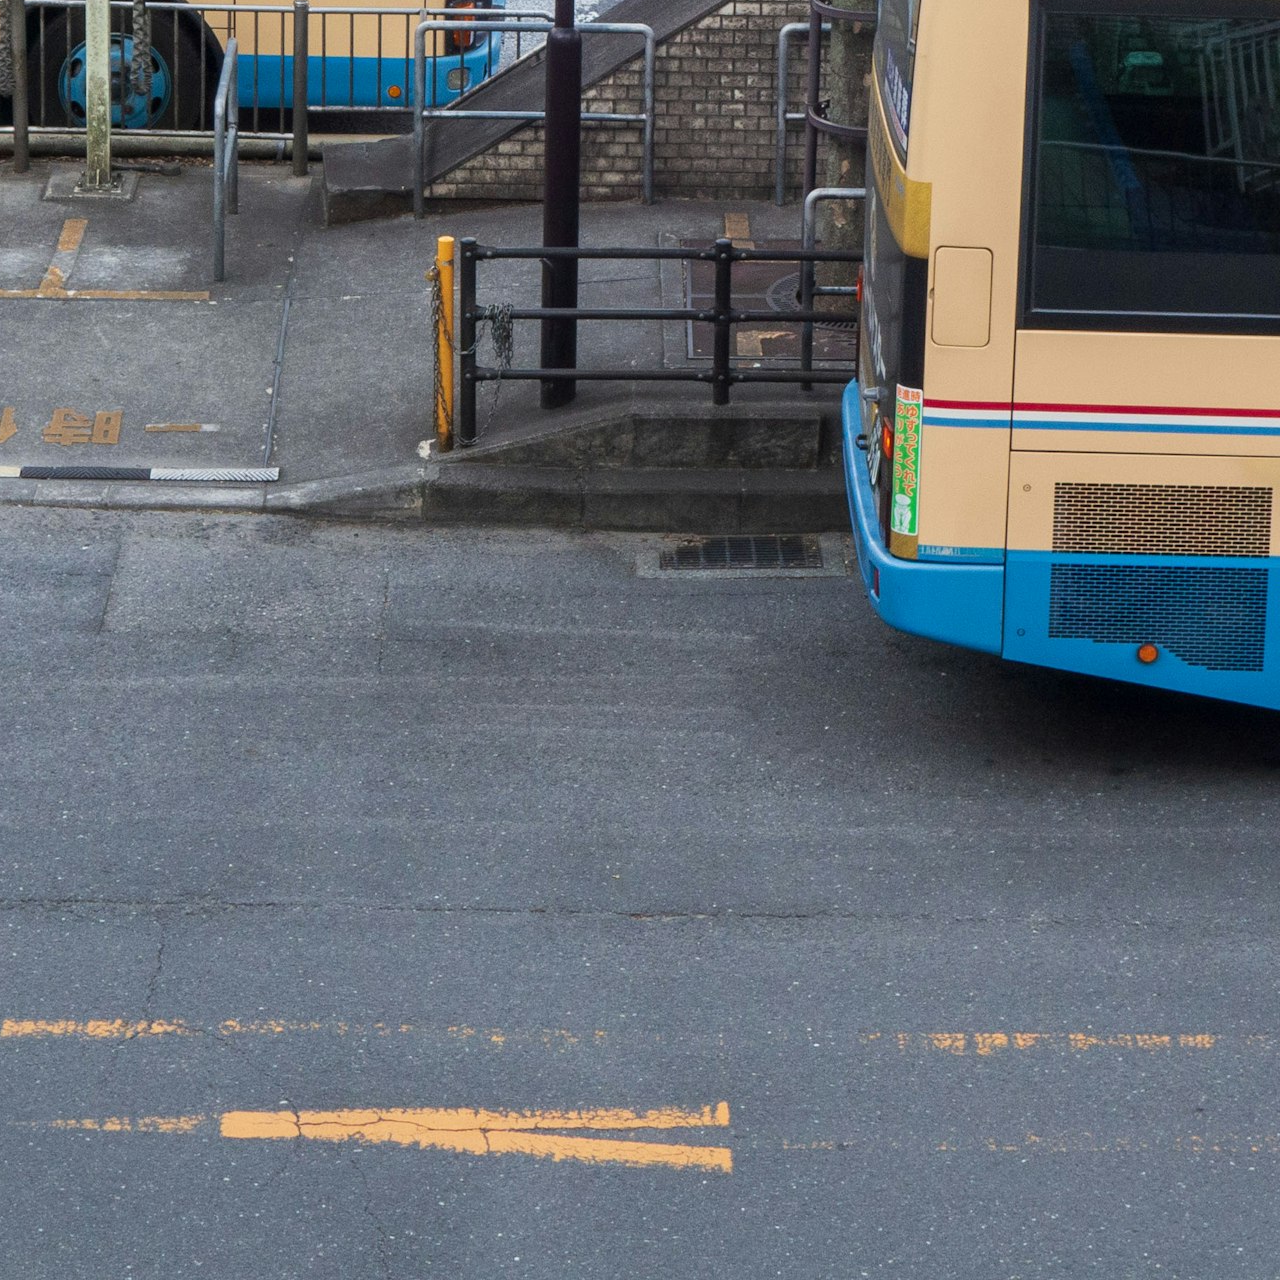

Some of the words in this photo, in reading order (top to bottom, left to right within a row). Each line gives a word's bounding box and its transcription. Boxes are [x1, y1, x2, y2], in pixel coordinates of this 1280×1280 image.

[903, 405, 919, 497] ゆずってくれて
